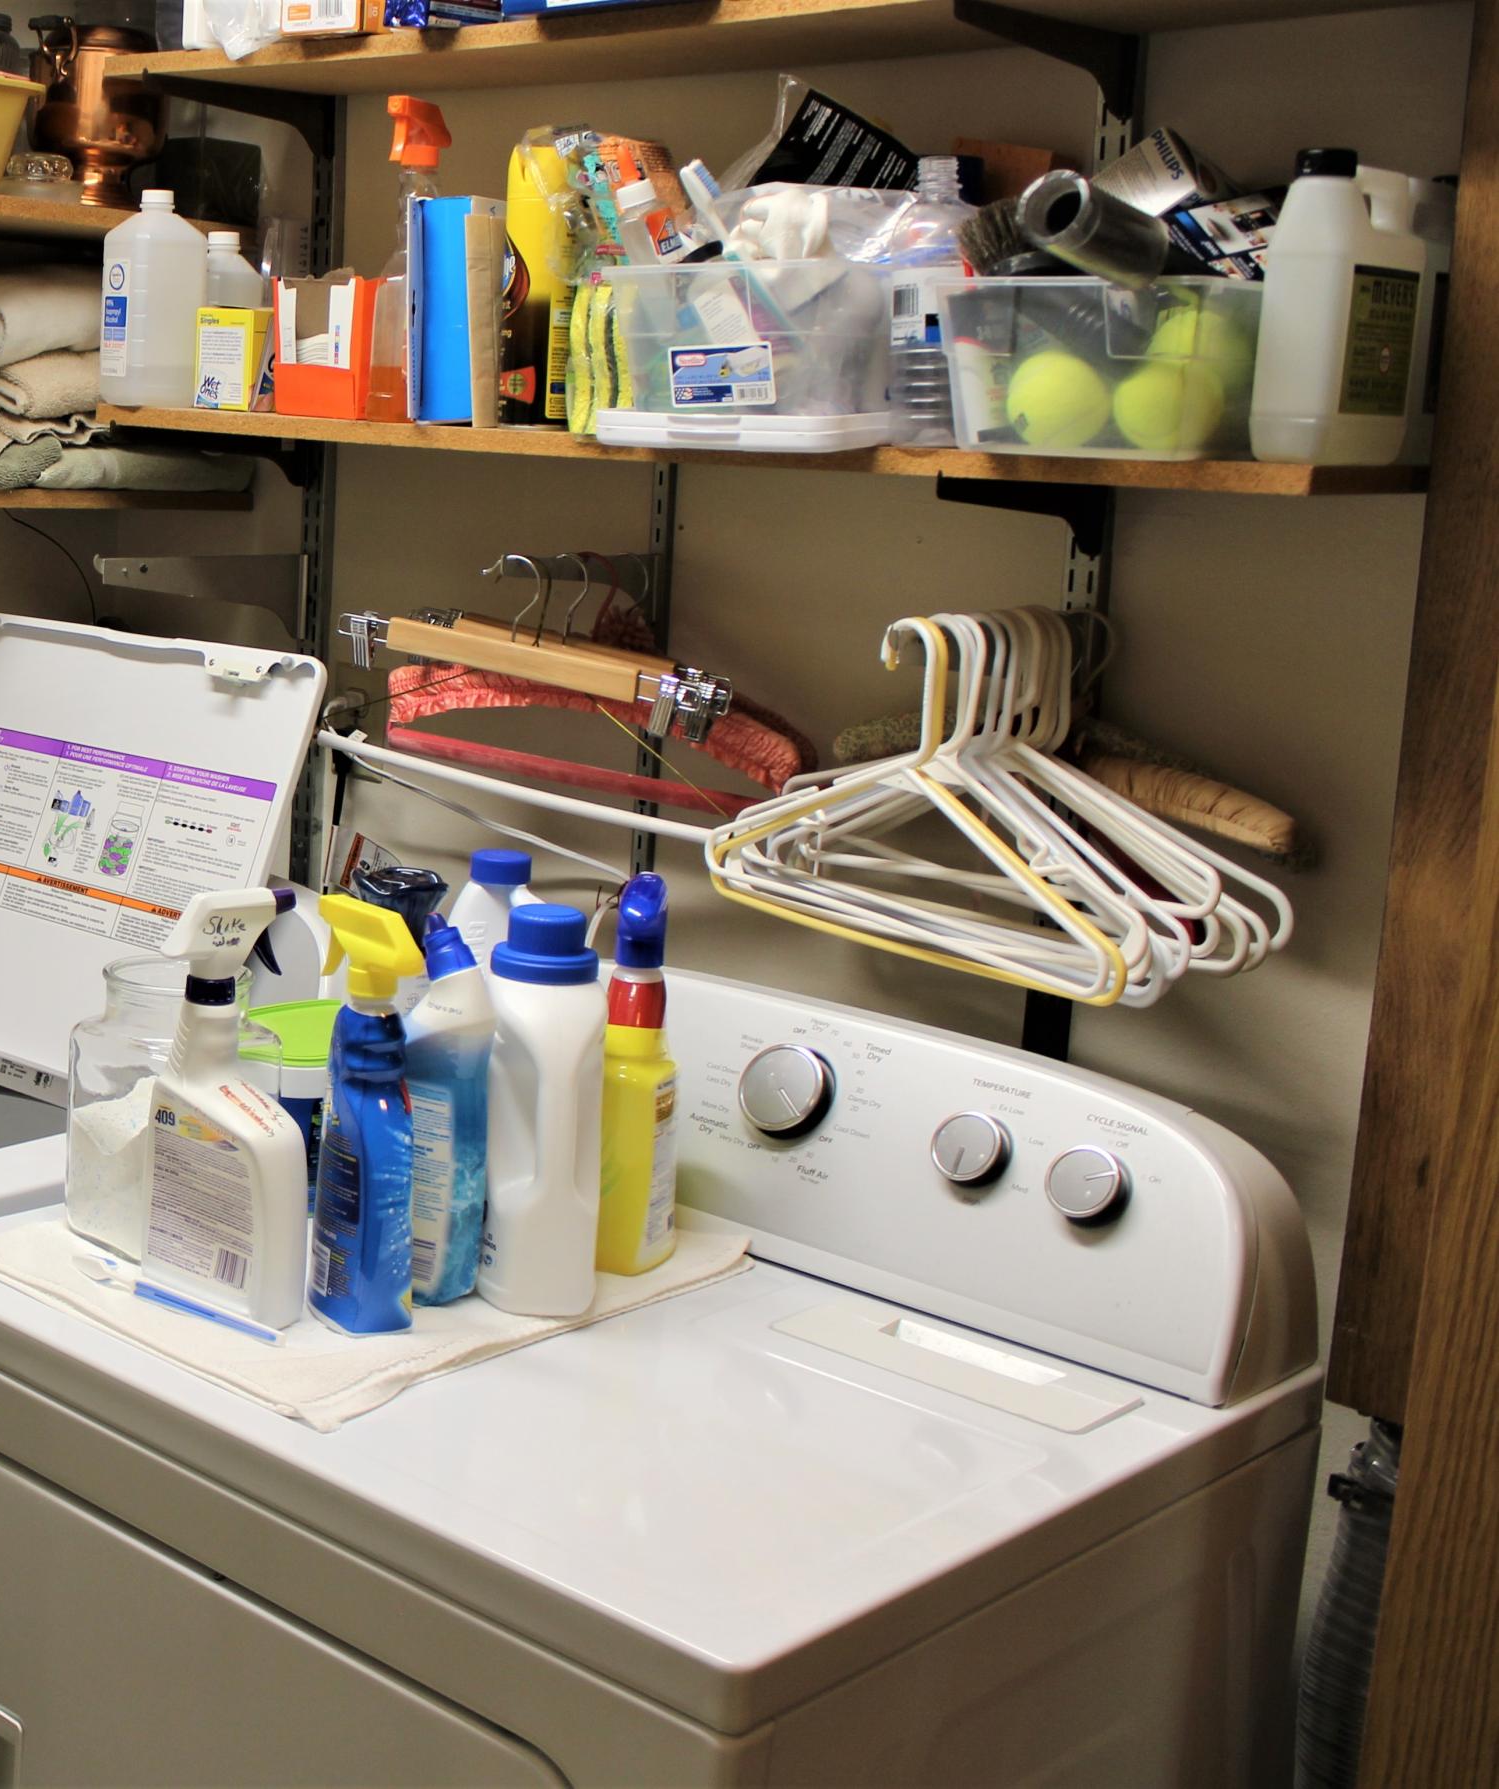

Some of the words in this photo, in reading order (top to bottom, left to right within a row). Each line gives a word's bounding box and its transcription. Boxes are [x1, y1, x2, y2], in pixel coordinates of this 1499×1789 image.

[1151, 129, 1185, 180] PHILIPS
[200, 316, 220, 326] Singles
[203, 374, 222, 391] Wet
[199, 384, 219, 400] Ones
[71, 745, 80, 753] FOR
[81, 747, 93, 755] BEST
[93, 749, 126, 762] PERFORMANCE
[69, 751, 82, 760] POUR
[90, 756, 123, 769] PERFORMANCE
[123, 762, 149, 773] OPTIMALE
[173, 765, 196, 775] STARTING
[196, 770, 210, 778] YOUR
[210, 773, 230, 782] WASHER
[190, 776, 211, 786] MARCHE
[225, 783, 248, 793] LAVEUSE
[43, 877, 90, 894] AVERTISSEMENT
[157, 907, 181, 920] ADVERT
[792, 1027, 807, 1035] OFF
[865, 1043, 892, 1056] Timed
[866, 1052, 884, 1063] Dry
[706, 1061, 721, 1070] Cool
[706, 1075, 720, 1084] Less
[720, 1078, 732, 1088] Dry
[972, 1078, 1032, 1100] TEMPERATURE
[847, 1094, 868, 1106] Damp
[868, 1099, 883, 1109] Dry
[717, 1104, 730, 1113] Dry
[998, 1103, 1008, 1113] Ex
[1008, 1105, 1025, 1116] Low
[154, 1109, 176, 1127] 409
[689, 1112, 731, 1130] Automatic
[1086, 1113, 1116, 1129] CYCLE
[1116, 1120, 1149, 1136] SIGNAL
[698, 1123, 714, 1136] Dry
[833, 1124, 850, 1134] Cool
[850, 1128, 871, 1139] Down
[733, 1137, 746, 1147] Dry
[747, 1142, 762, 1150] OFF
[818, 1135, 834, 1144] OFF
[1028, 1136, 1045, 1147] Low
[1115, 1139, 1130, 1149] Off
[796, 1164, 817, 1178] Fluff
[816, 1169, 829, 1180] Air
[1149, 1175, 1162, 1184] On
[1011, 1183, 1029, 1194] Med
